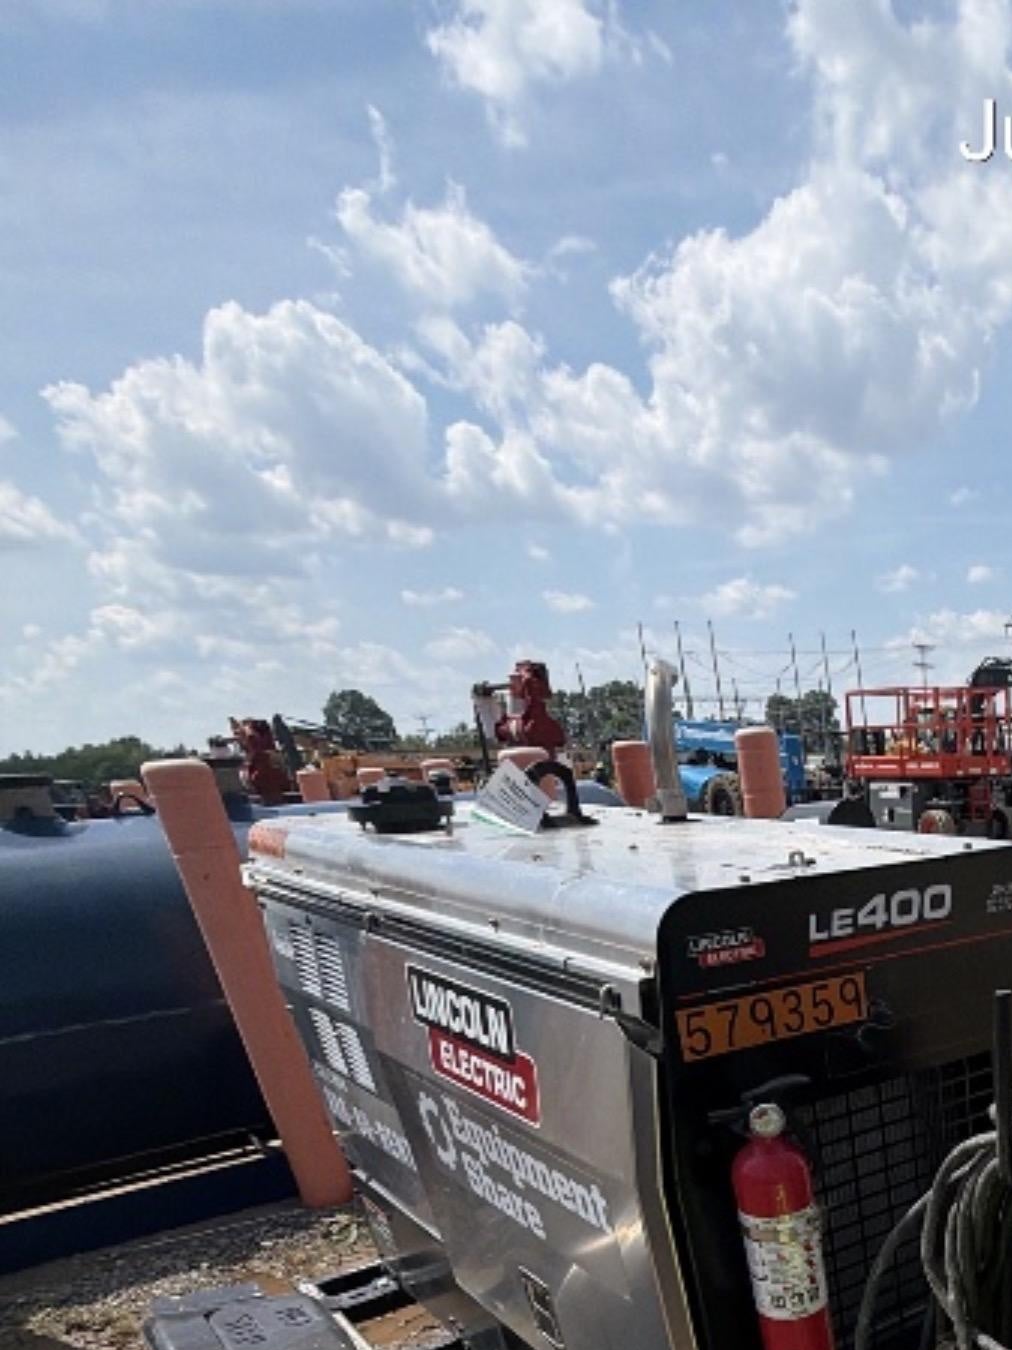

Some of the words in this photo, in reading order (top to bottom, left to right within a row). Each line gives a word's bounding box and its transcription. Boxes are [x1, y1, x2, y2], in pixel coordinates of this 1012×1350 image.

[808, 883, 953, 943] LE400
[410, 973, 509, 1055] LINCOLN
[684, 977, 864, 1057] 579359
[439, 1040, 527, 1109] ELECTRIC
[440, 1093, 614, 1236] Equipment
